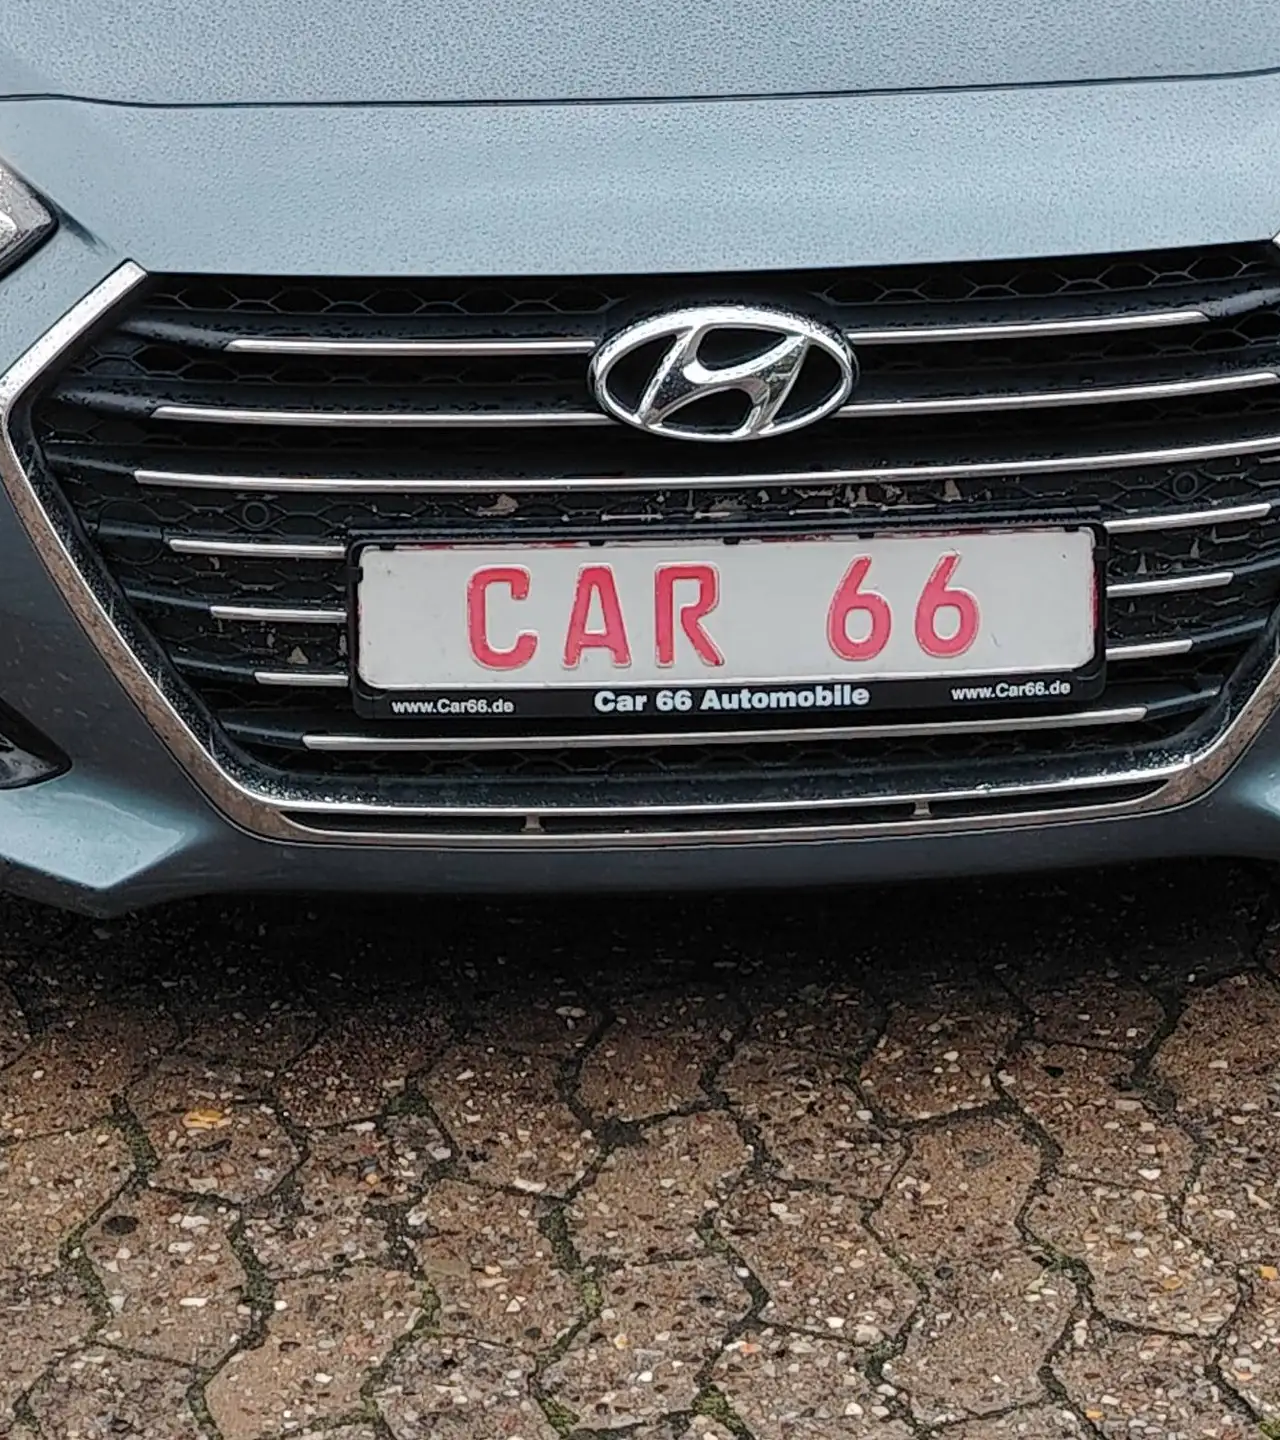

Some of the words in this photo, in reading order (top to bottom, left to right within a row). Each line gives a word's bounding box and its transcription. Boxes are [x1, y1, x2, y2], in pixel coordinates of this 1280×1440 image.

[467, 562, 724, 670] CAR
[827, 552, 981, 661] 66
[593, 690, 648, 712] Car
[655, 689, 693, 712] 66
[700, 684, 870, 711] Automobile
[950, 680, 1071, 702] www.Car66.de
[392, 697, 515, 715] www.Car66.de
